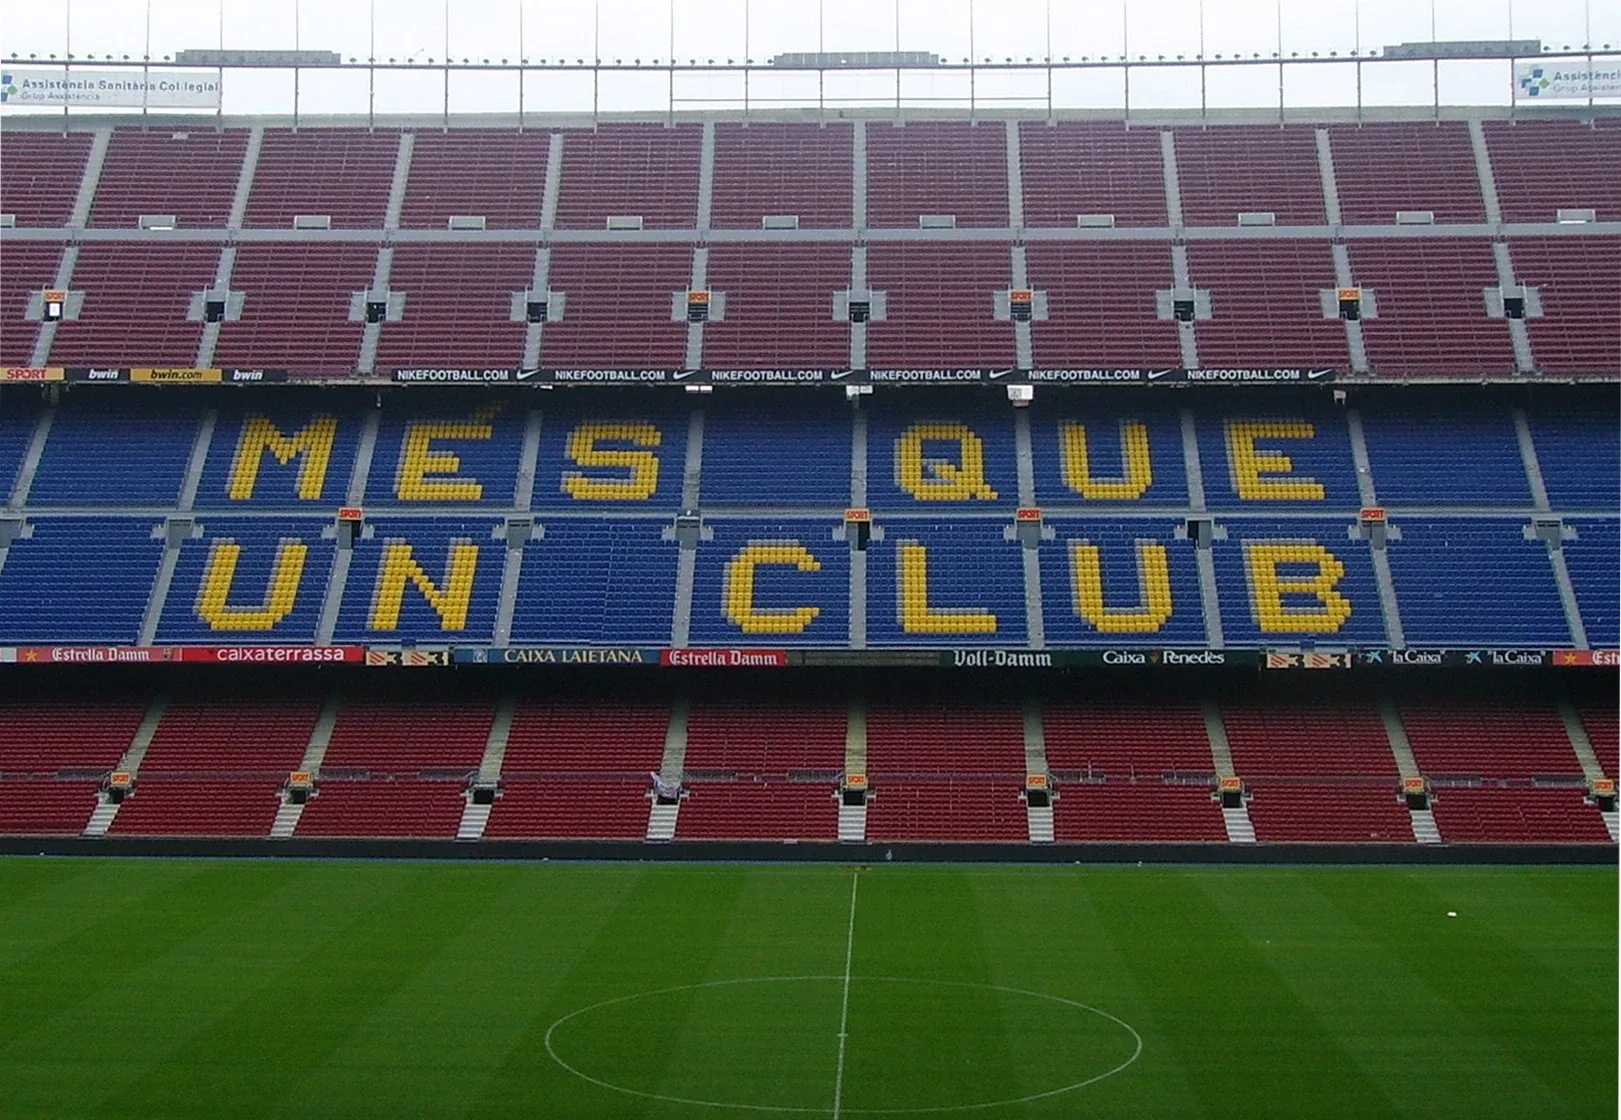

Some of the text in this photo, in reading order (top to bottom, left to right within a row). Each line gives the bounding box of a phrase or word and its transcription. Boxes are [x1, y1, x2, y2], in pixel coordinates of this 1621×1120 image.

[7, 369, 46, 379] SPORT
[89, 369, 118, 380] bwin
[150, 369, 202, 380] bwin.com
[233, 369, 262, 380] bwin
[398, 369, 508, 380] NIKEFOOTBALL.COM
[555, 369, 665, 380] NIKEFOOTBALL.COM
[711, 370, 823, 380] NIKEFOOTBALL.COM
[870, 370, 981, 380] NIKEFOOTBALL.COM
[1028, 370, 1140, 380] NIKEFOOTBALL.COM
[1187, 370, 1300, 380] NIKEFOOTBALL.COM
[52, 648, 150, 662] Estrella Damm
[217, 648, 345, 661] caixaterrassa
[504, 650, 643, 664] CAIXA LAIETANA
[669, 650, 778, 666] Estrella Damm
[954, 650, 1052, 667] Voll-Damm
[1103, 650, 1146, 665] Caixa
